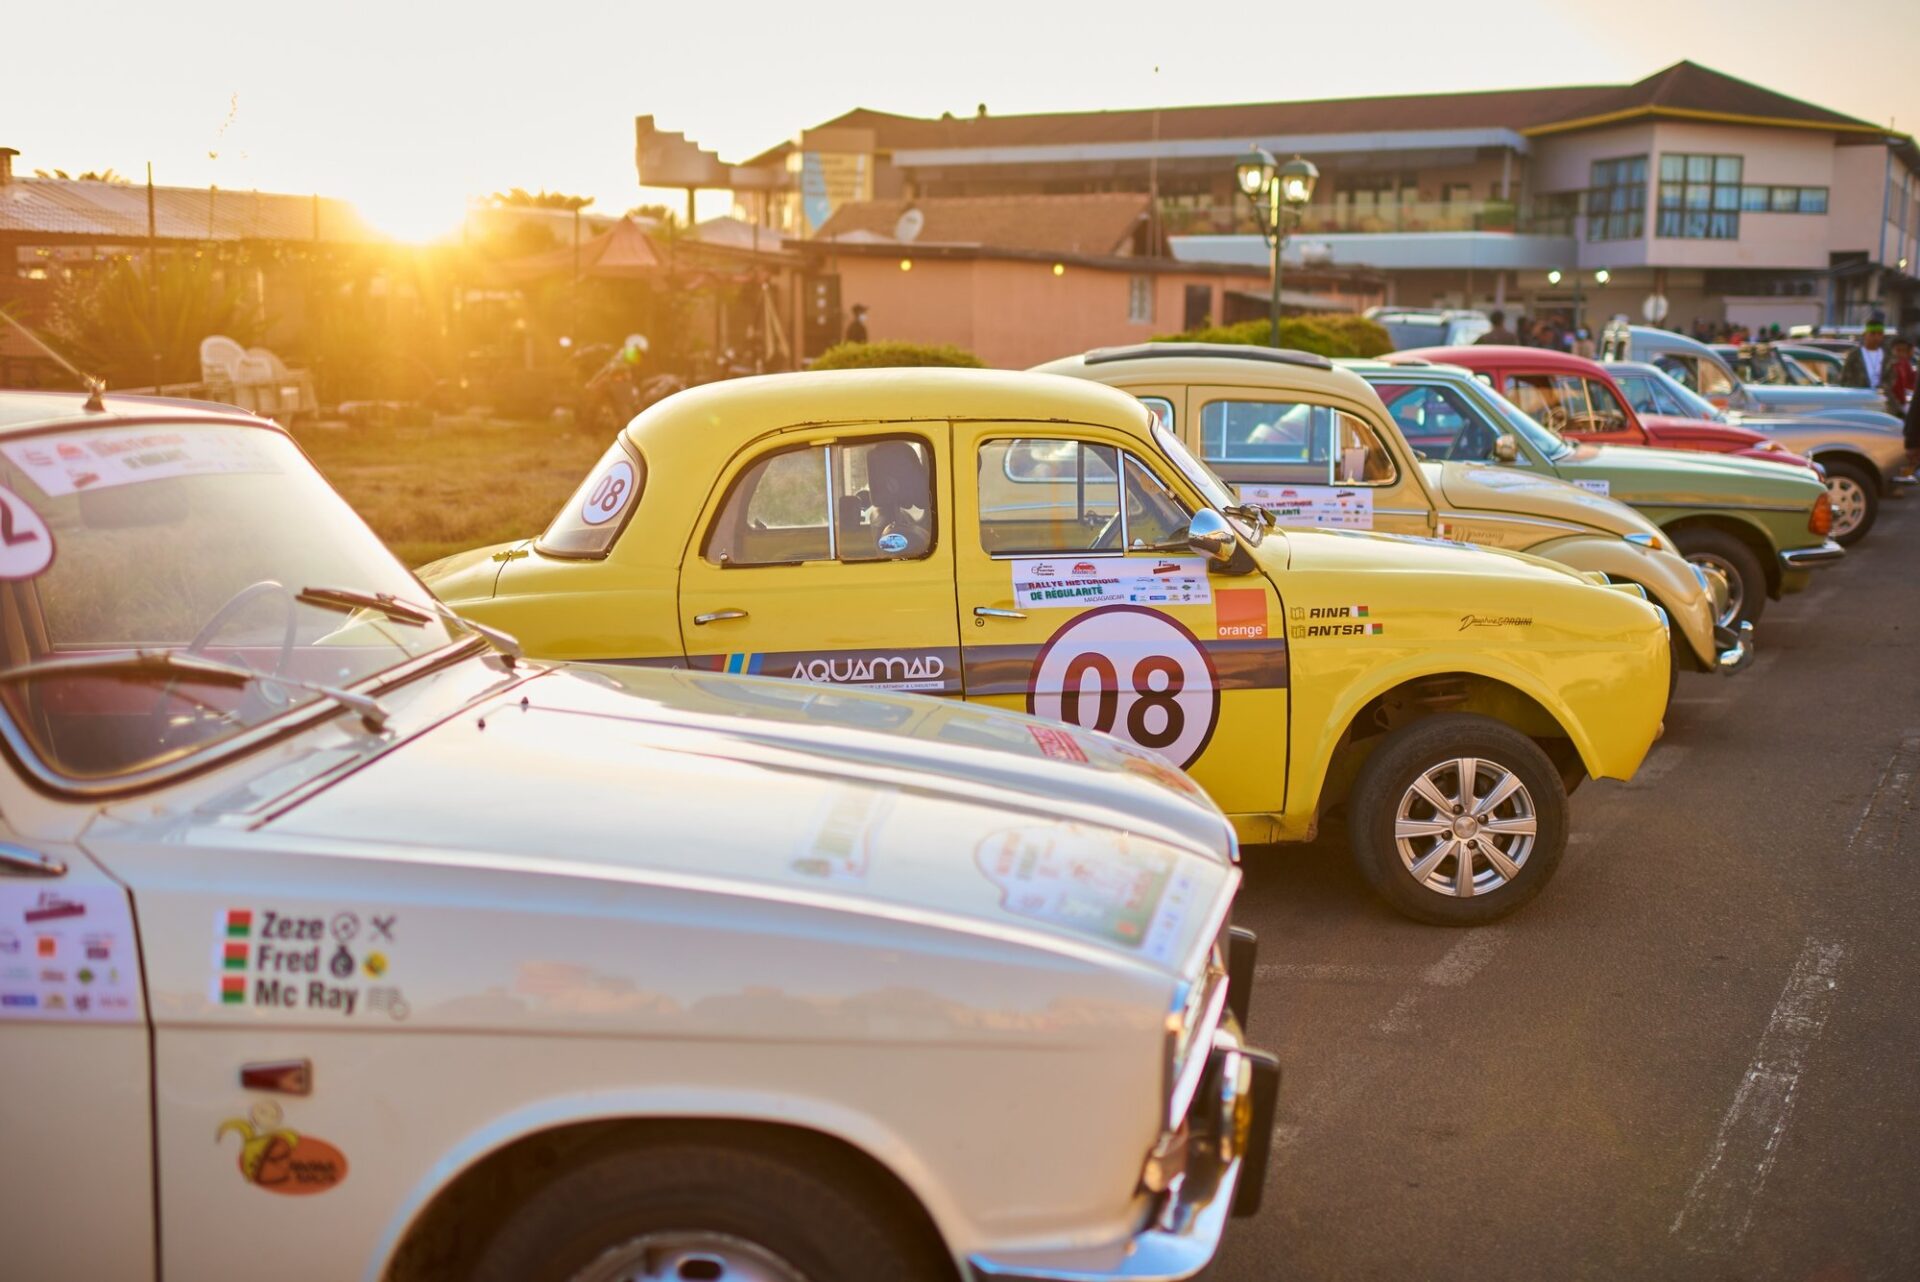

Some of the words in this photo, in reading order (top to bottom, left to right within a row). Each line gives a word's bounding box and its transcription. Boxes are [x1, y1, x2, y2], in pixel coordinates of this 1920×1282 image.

[590, 475, 625, 511] 08
[1028, 580, 1064, 590] RALLYE
[1030, 591, 1045, 601] DE
[1045, 585, 1104, 600] RÉGULARITÉ
[1219, 624, 1263, 637] orange
[1308, 624, 1364, 637] ANTSA
[791, 656, 944, 682] AQUAMAD
[1061, 652, 1185, 748] 08
[261, 910, 324, 940] Zeze
[257, 945, 320, 972] Fred
[255, 979, 297, 1008] Mc
[307, 981, 358, 1015] Ray
